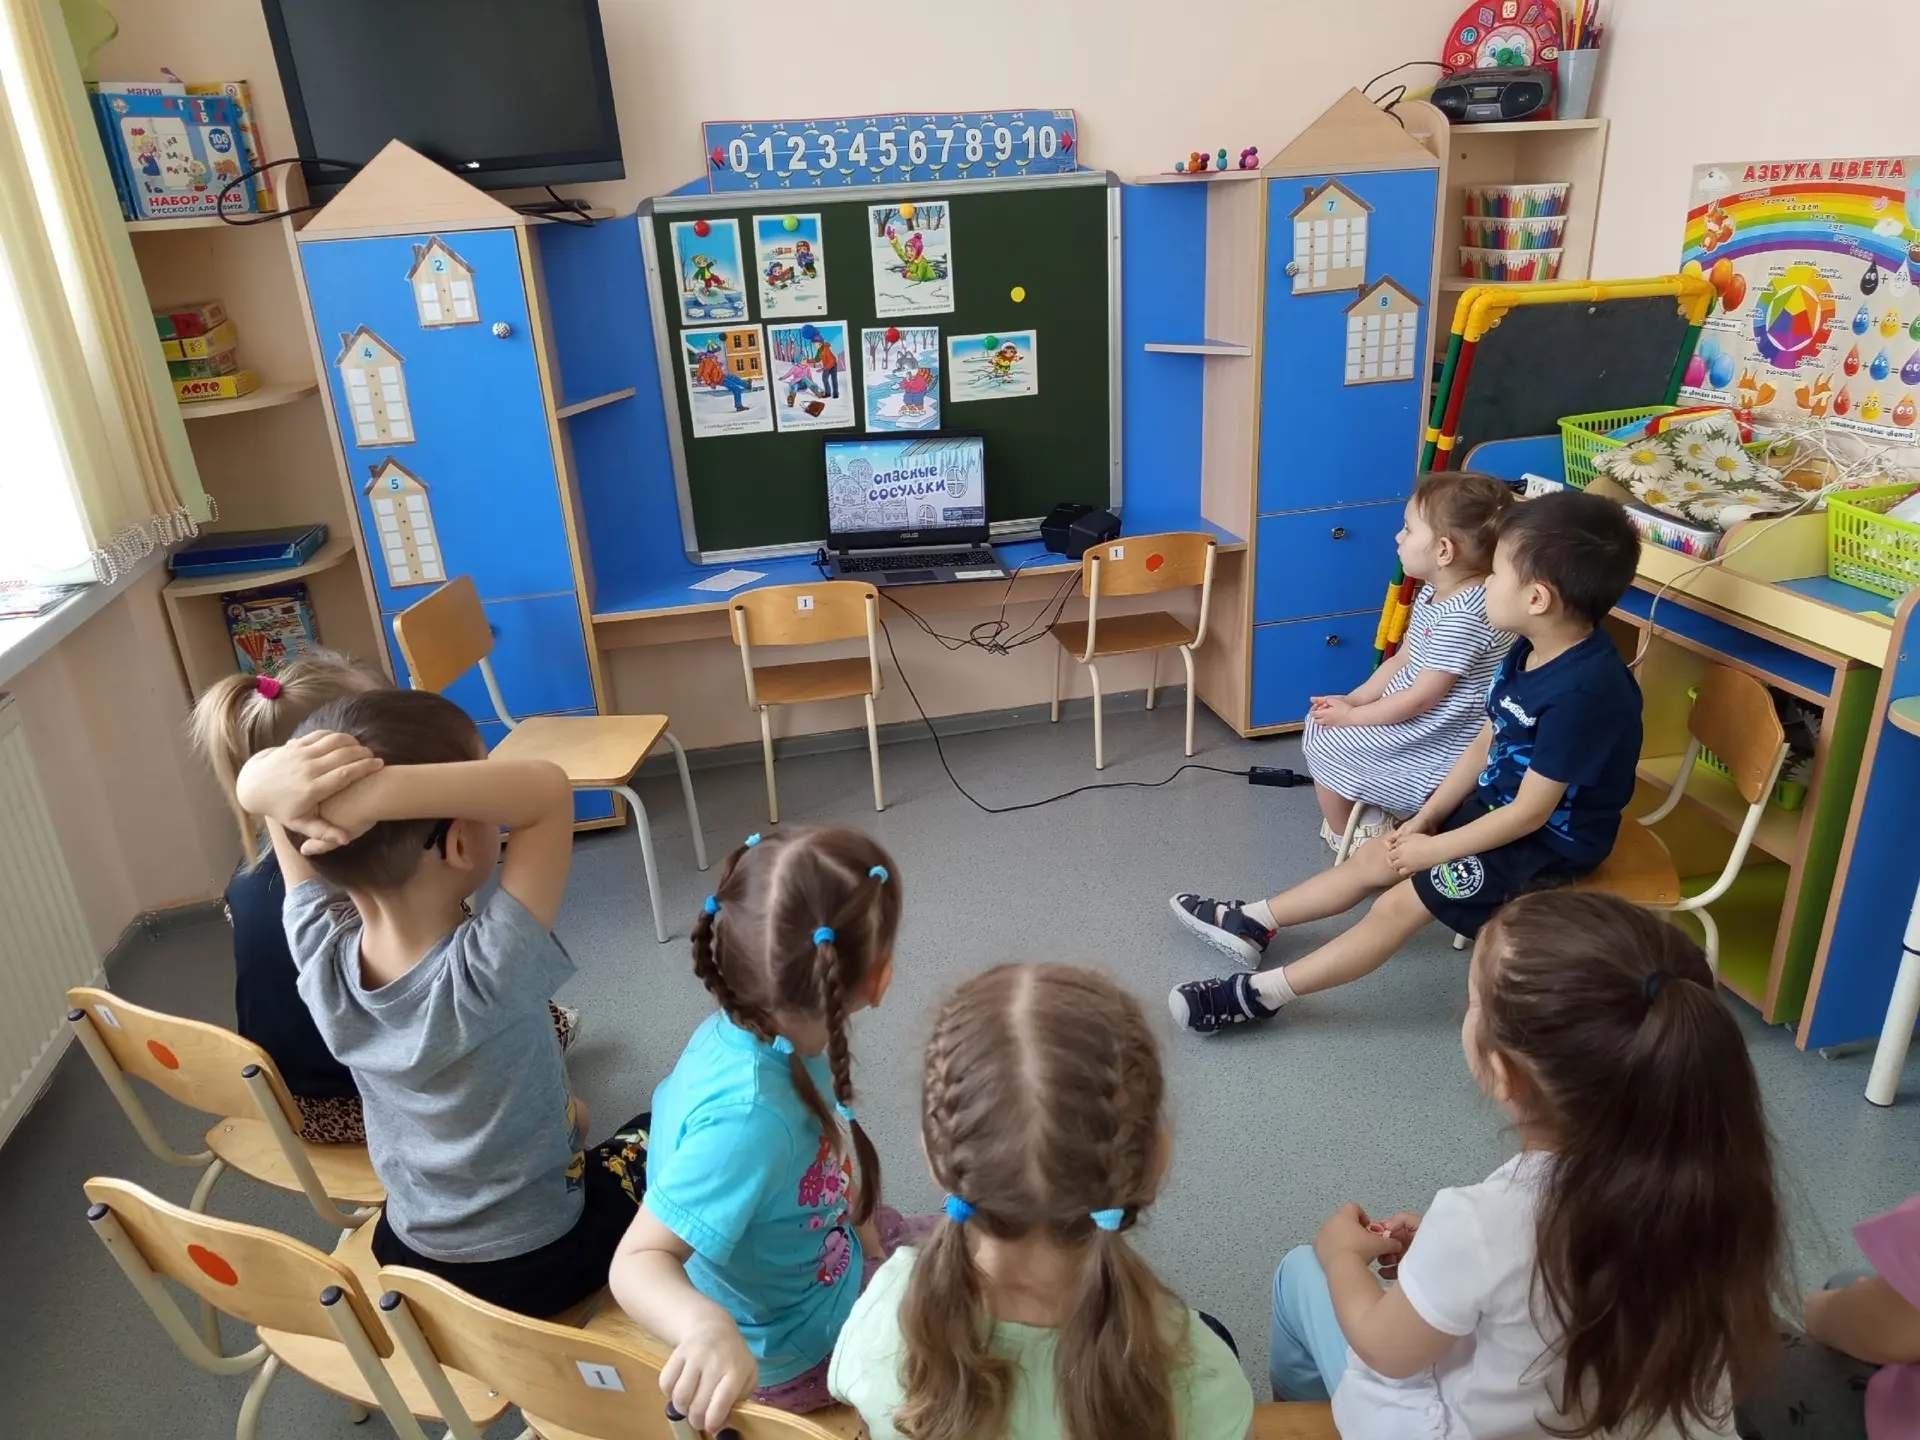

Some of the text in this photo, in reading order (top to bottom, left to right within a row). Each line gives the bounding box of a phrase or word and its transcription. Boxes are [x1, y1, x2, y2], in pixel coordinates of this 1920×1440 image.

[1504, 4, 1516, 14] 12
[1463, 32, 1474, 41] 10
[1457, 54, 1465, 65] 9
[728, 126, 1057, 173] 0 1 2 3 4 5 6 7 8 9 10
[1742, 159, 1906, 182] АЗБУКА ЦВЕТА
[148, 195, 200, 206] НАБОР
[1328, 200, 1336, 212] 7
[151, 204, 244, 214] РУССКОГО АЛФВИТА
[434, 260, 444, 272] 2
[1380, 296, 1388, 307] 8
[364, 348, 372, 358] 4
[391, 478, 399, 490] 5
[592, 1370, 607, 1386] 1
